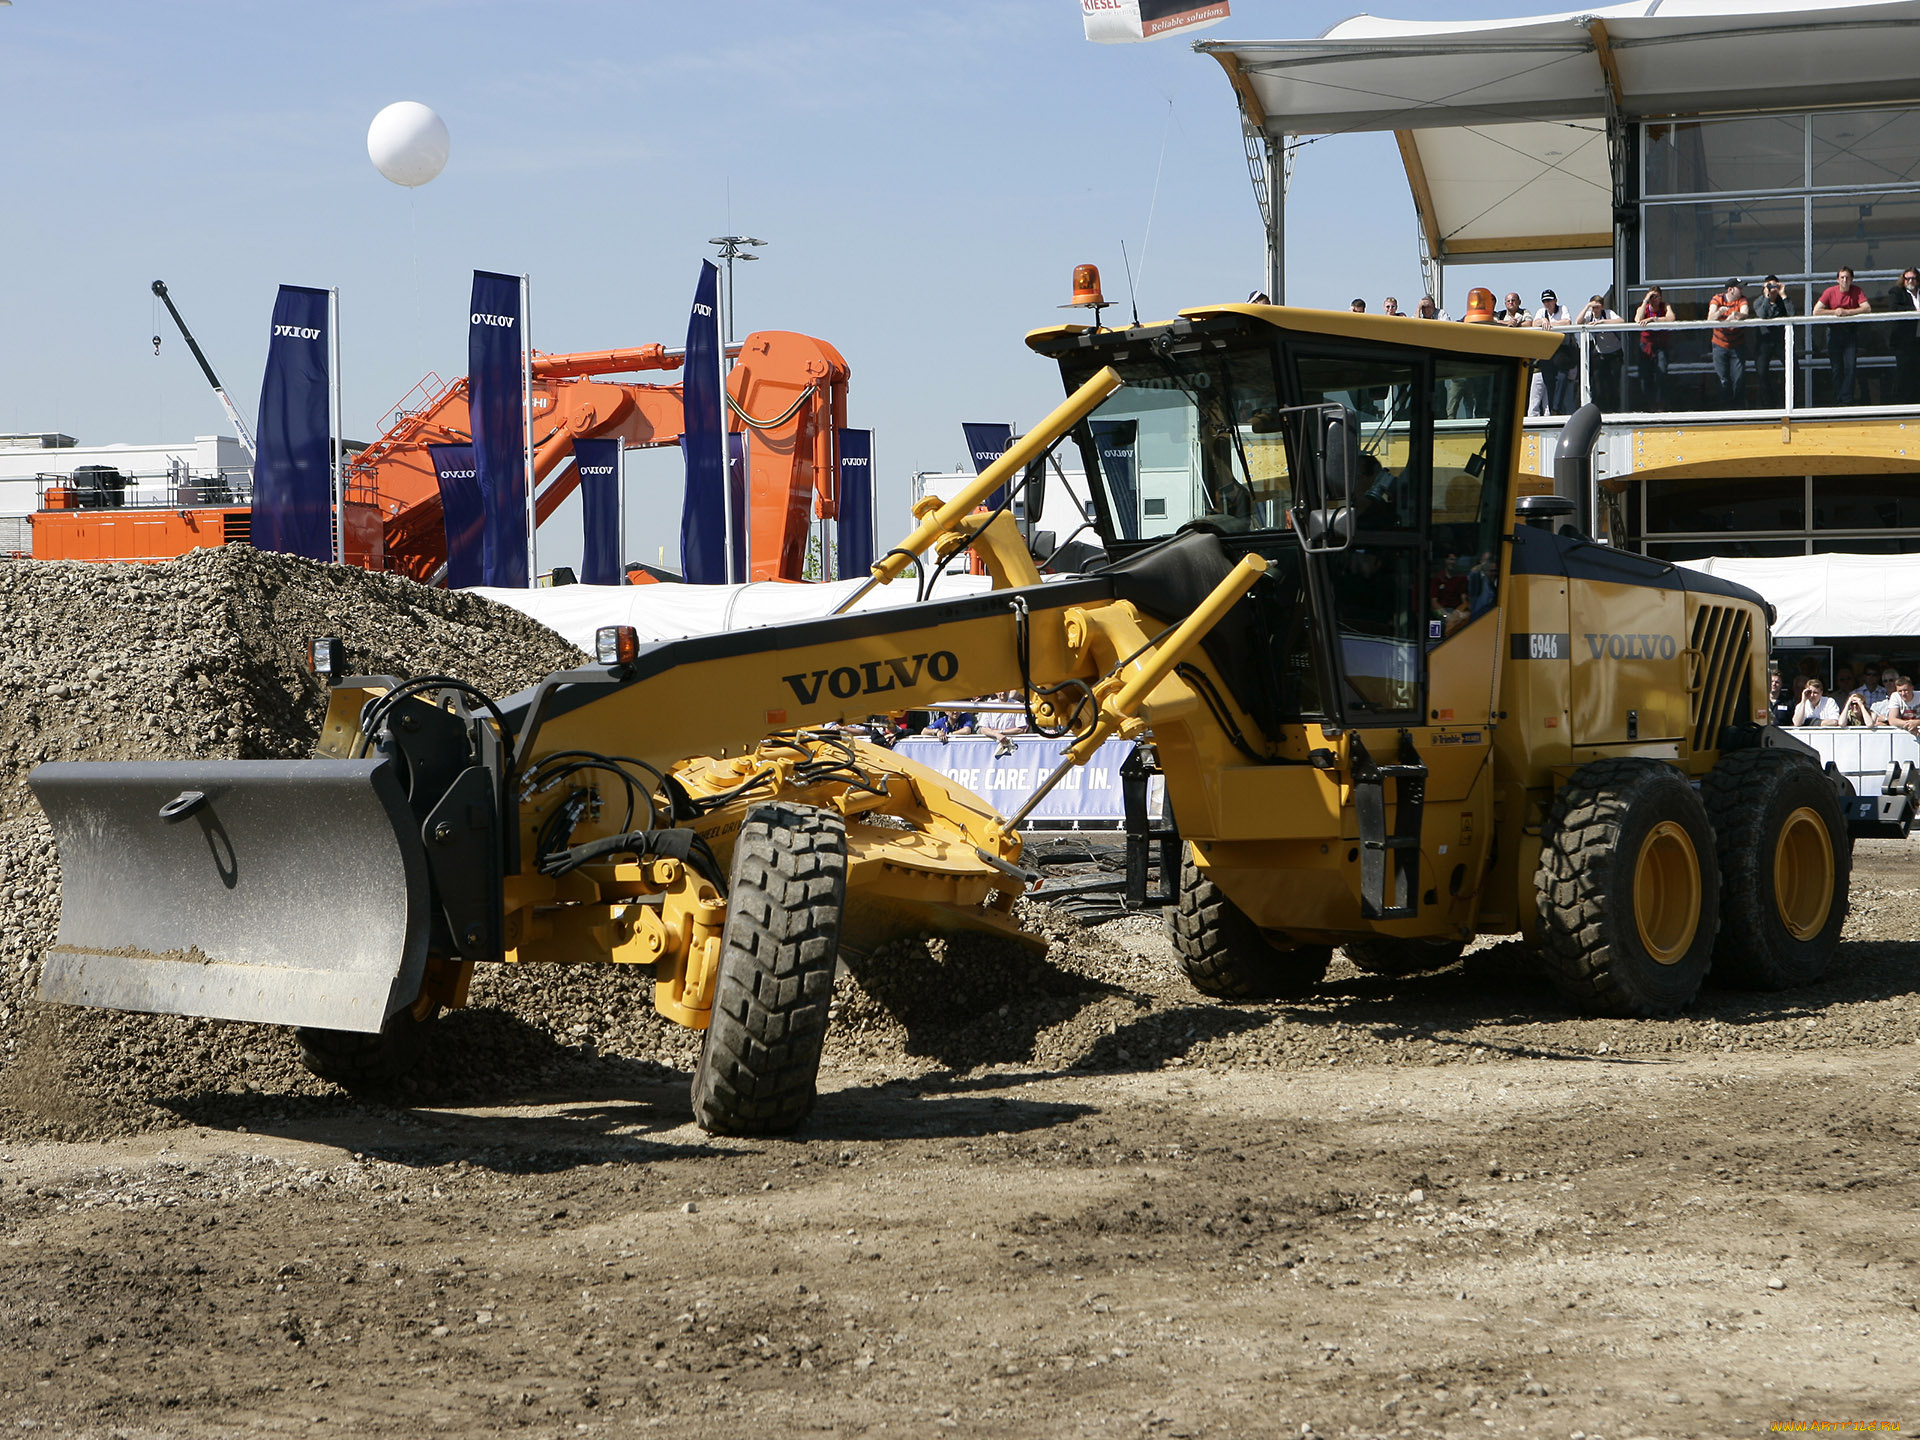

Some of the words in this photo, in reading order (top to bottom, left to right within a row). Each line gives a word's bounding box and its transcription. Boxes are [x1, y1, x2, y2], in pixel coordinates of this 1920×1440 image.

[1083, 0, 1121, 10] KIESEL
[1151, 17, 1184, 32] Reliable
[1186, 8, 1224, 22] solutions
[1530, 634, 1557, 659] G946
[1584, 633, 1676, 660] VOLVO
[782, 651, 959, 705] VOLVO
[984, 768, 1031, 790] CARE.
[1088, 767, 1112, 790] IN.
